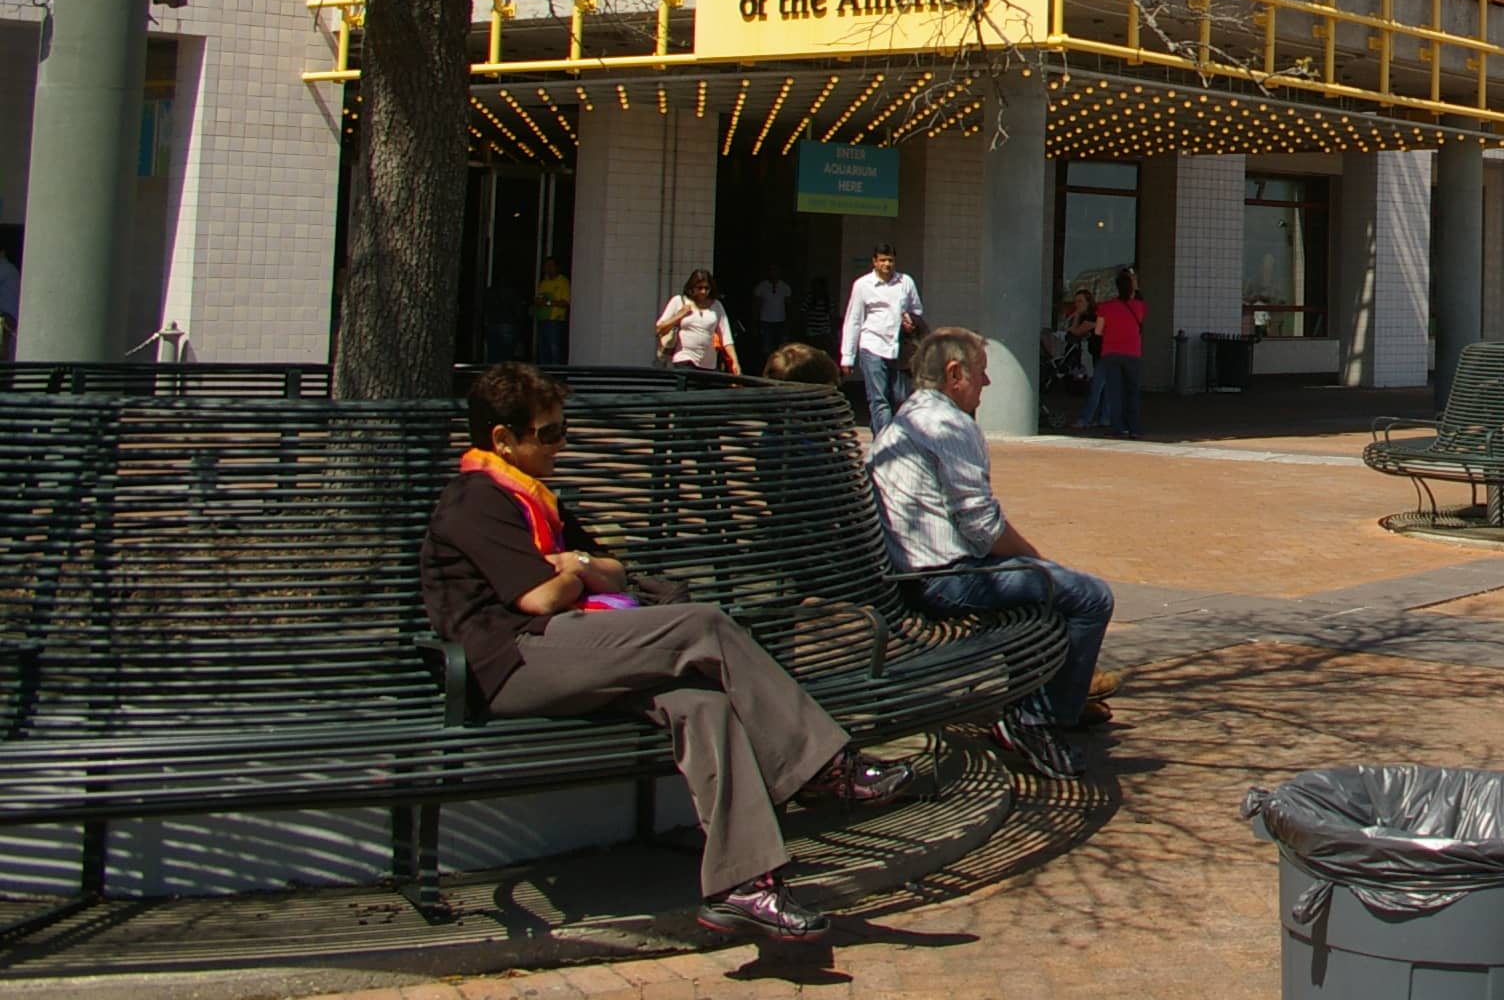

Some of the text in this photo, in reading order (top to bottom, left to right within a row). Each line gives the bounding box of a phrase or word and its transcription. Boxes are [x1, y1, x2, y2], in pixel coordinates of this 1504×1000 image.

[837, 148, 865, 160] ENTER
[825, 163, 877, 177] AQUARIUM
[839, 180, 864, 192] HERE
